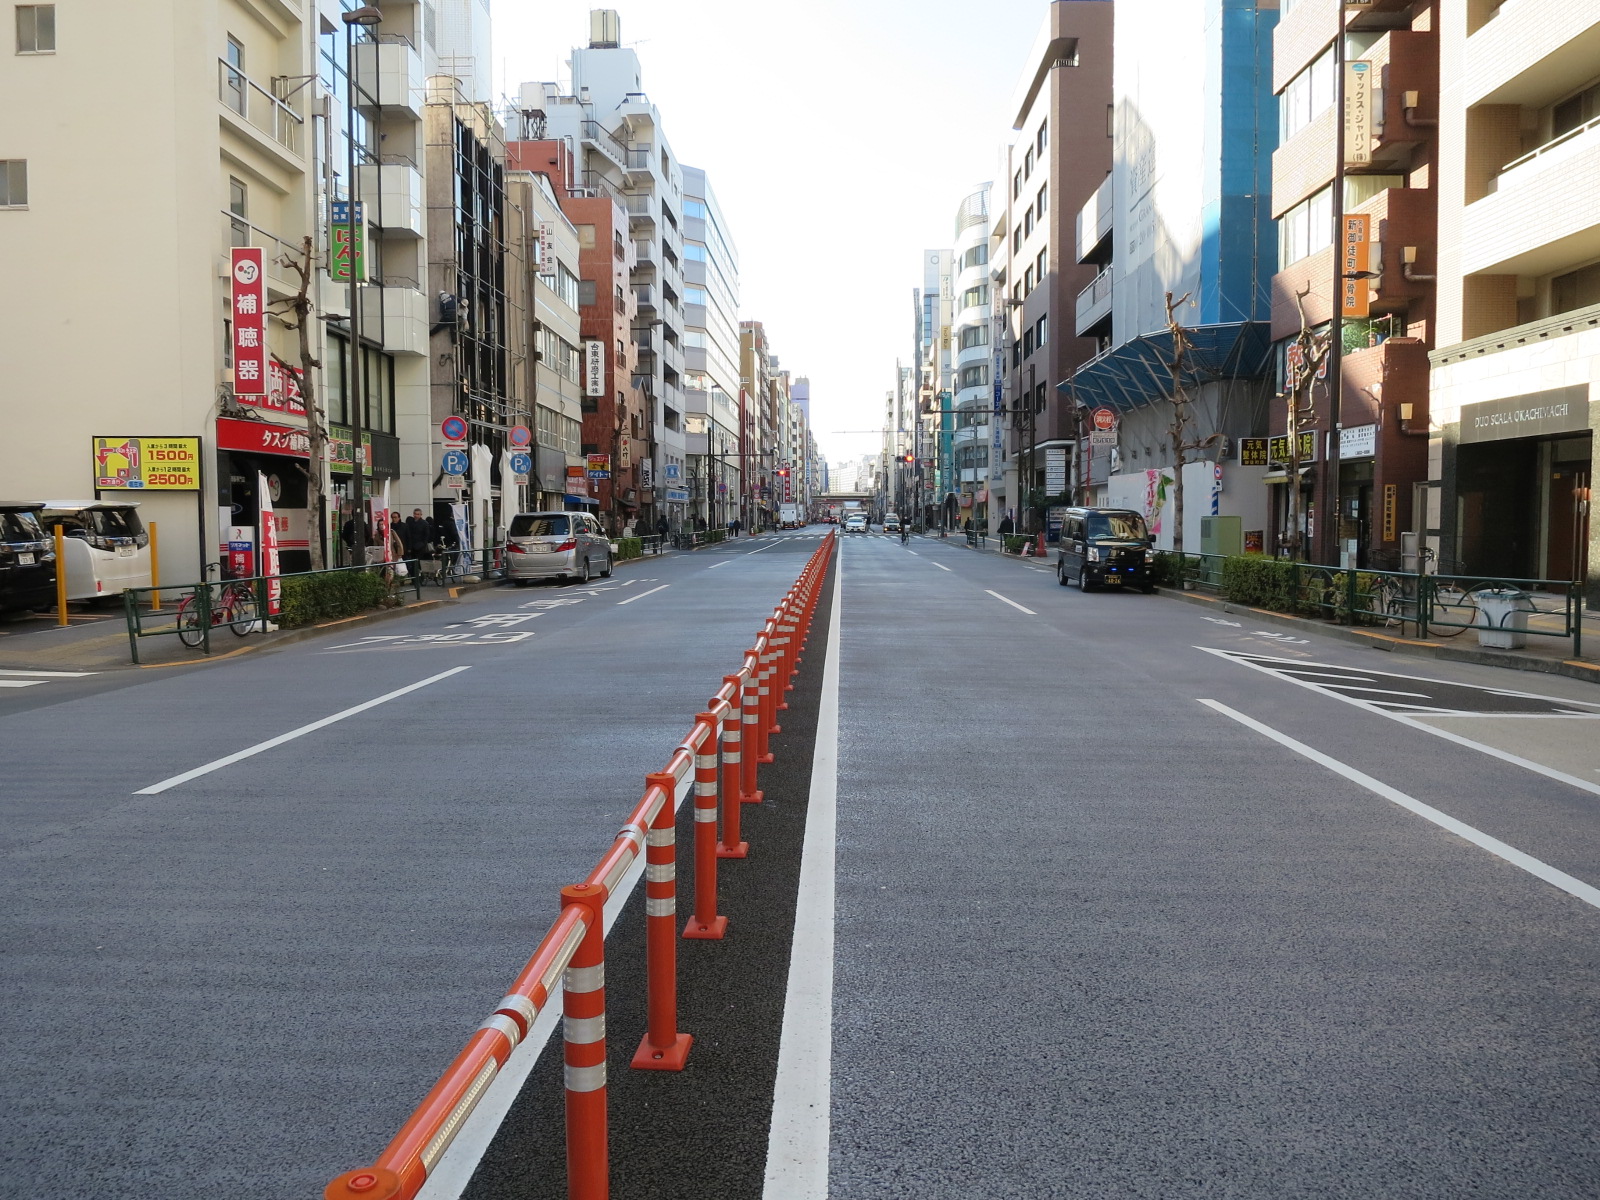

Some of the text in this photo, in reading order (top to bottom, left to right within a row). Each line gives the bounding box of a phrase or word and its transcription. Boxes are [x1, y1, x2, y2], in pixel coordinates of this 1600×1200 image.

[236, 293, 259, 380] 補聴器
[1474, 403, 1569, 428] DUO SCALA OKACHIMACHI
[1246, 440, 1263, 450] 元気
[148, 450, 194, 461] 1500円
[1242, 450, 1267, 460] 整体院
[448, 455, 458, 471] P
[514, 458, 523, 471] P
[147, 473, 193, 485] 2500円
